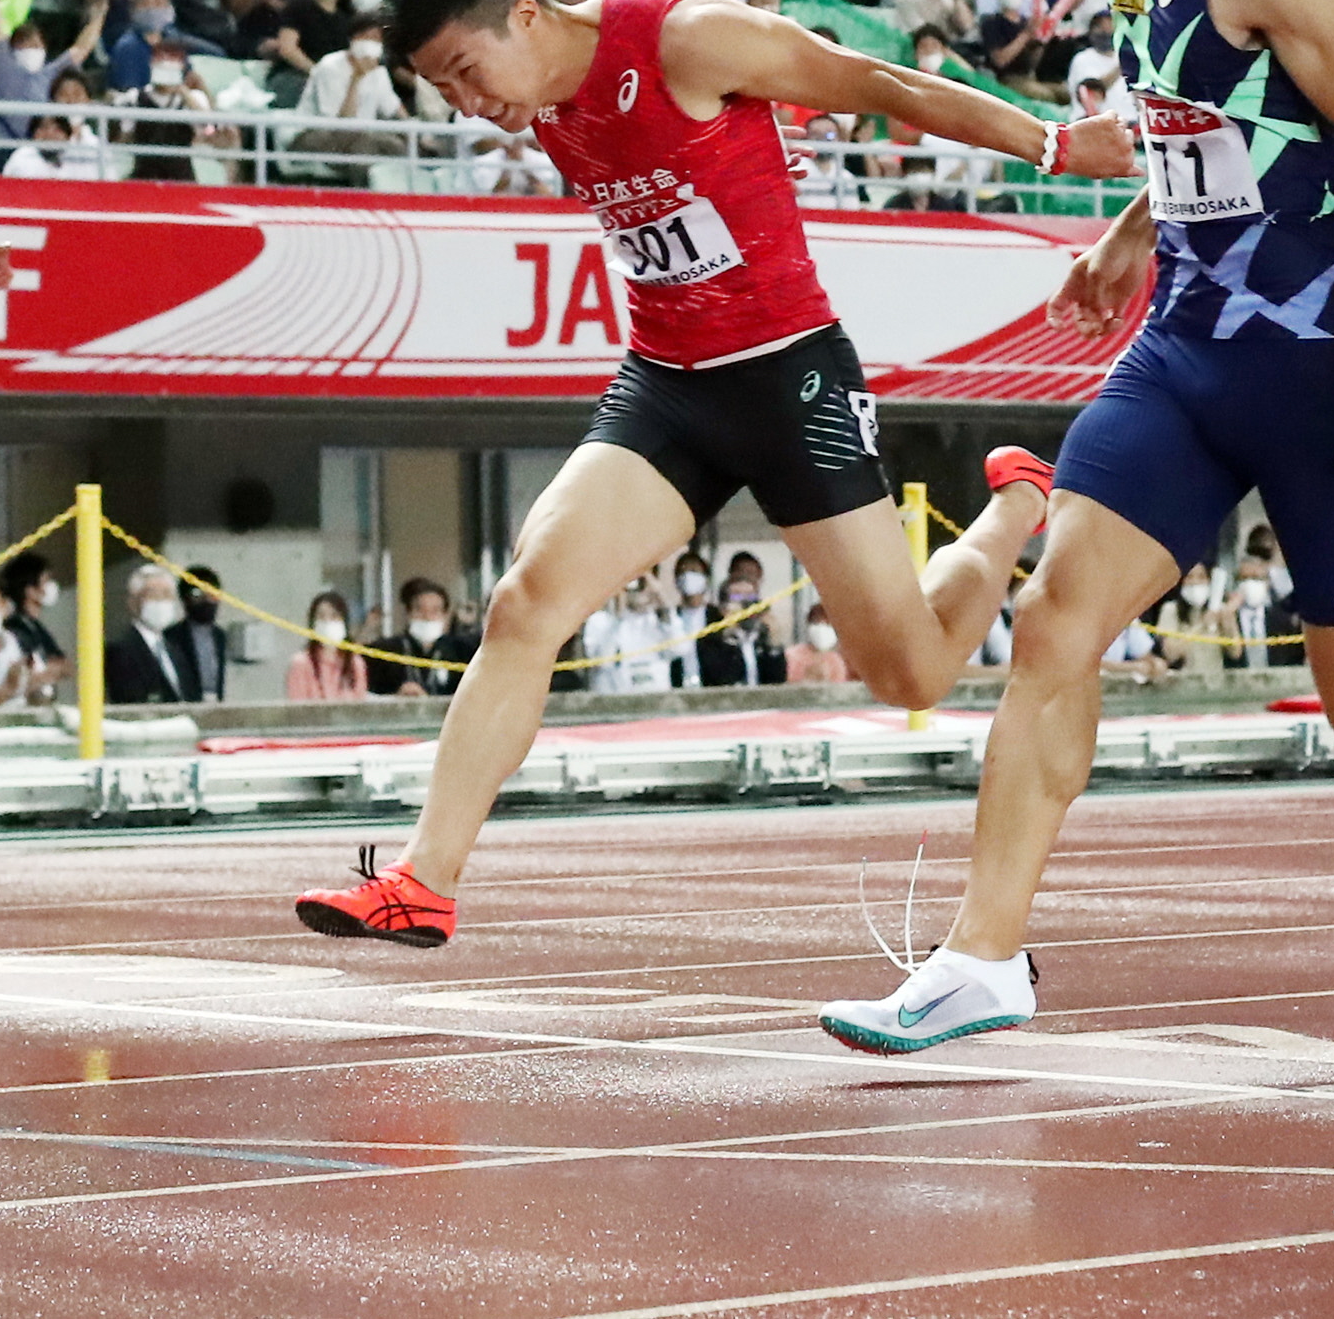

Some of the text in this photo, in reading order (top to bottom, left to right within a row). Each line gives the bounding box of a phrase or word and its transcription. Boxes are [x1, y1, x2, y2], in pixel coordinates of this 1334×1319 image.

[593, 168, 680, 202] 日本生命
[619, 216, 701, 276] 301
